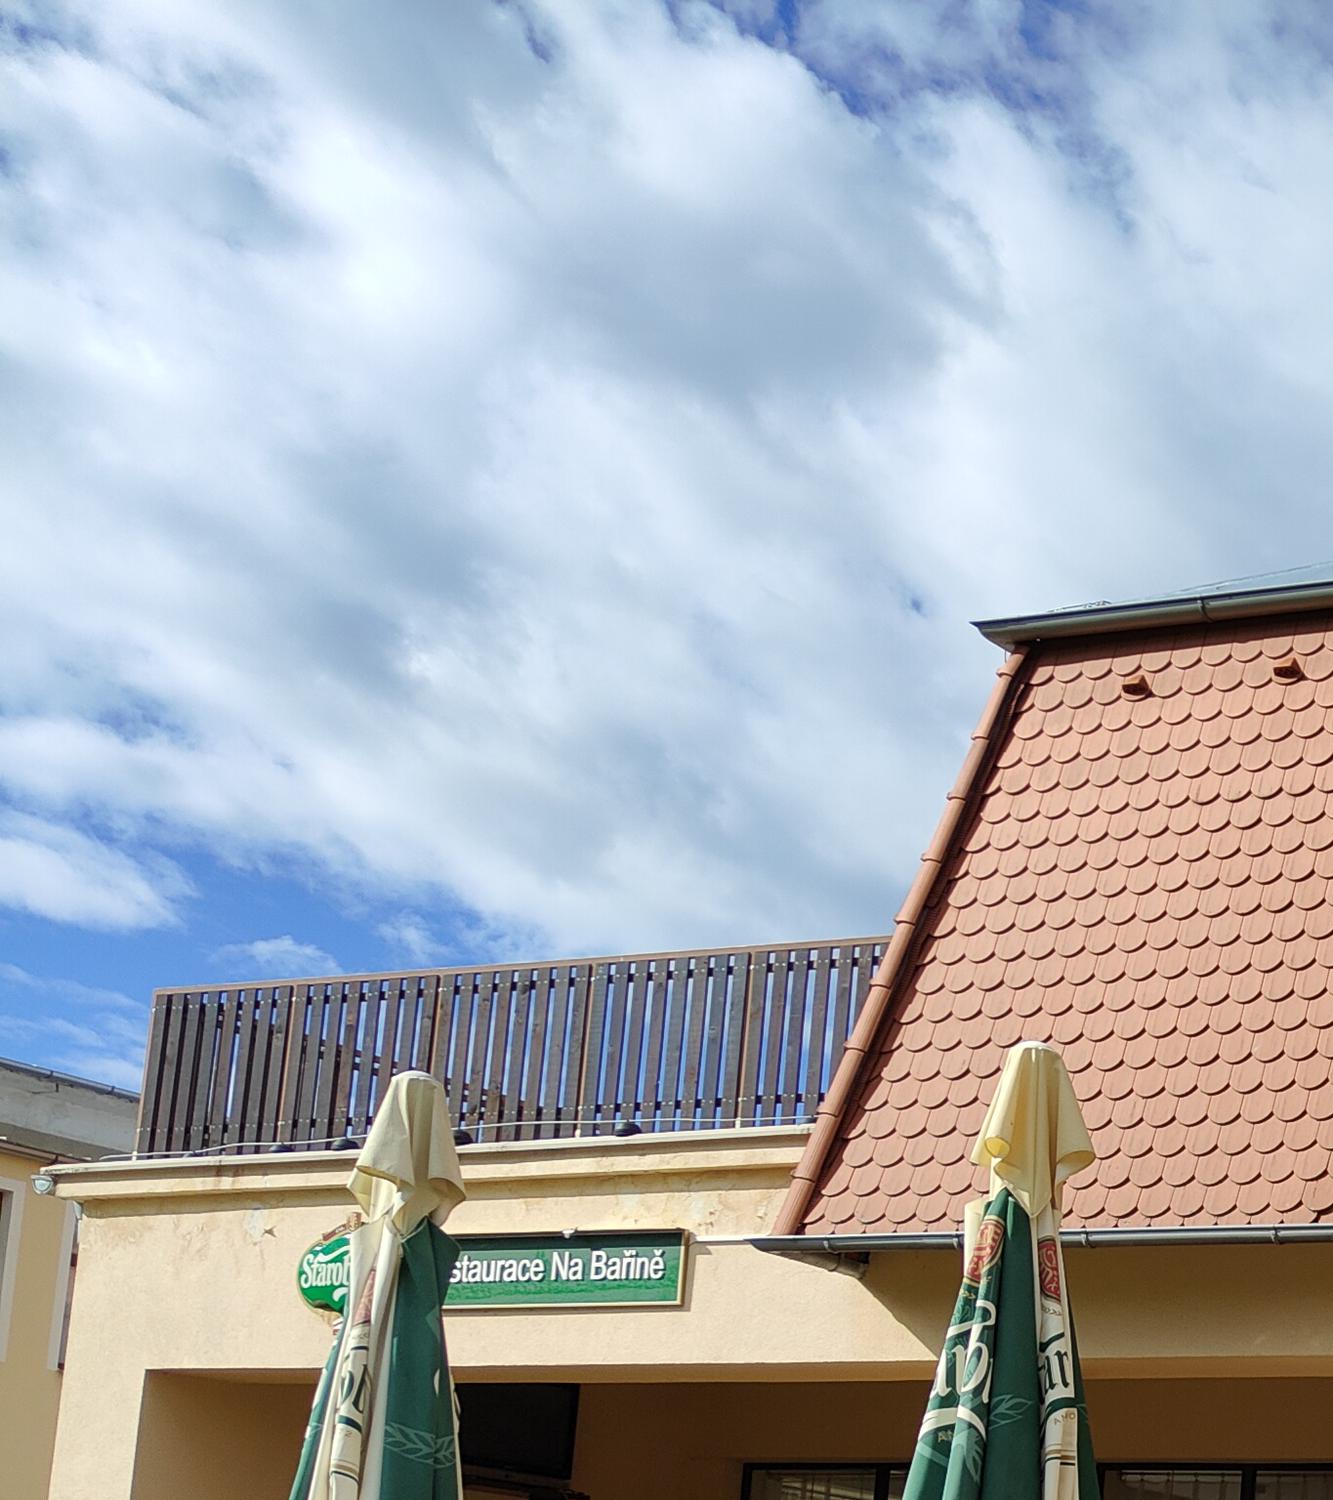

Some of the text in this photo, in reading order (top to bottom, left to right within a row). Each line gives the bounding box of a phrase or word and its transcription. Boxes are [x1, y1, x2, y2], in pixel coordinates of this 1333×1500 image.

[449, 1249, 665, 1283] staurace Na Bařině
